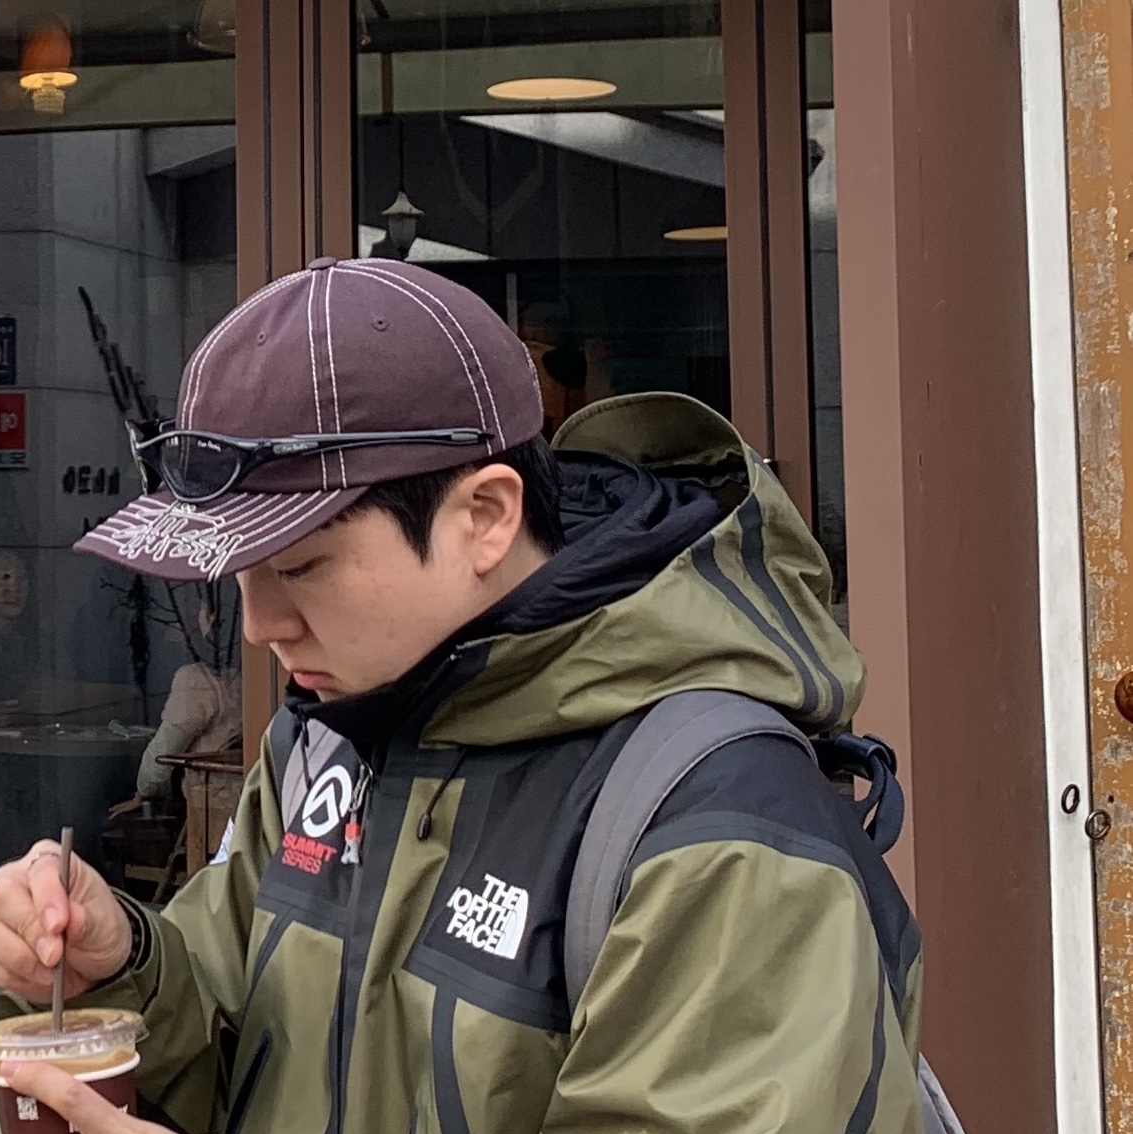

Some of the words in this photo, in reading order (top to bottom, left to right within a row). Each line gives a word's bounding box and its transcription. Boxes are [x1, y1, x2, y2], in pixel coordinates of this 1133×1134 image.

[281, 850, 322, 875] SERIES
[282, 832, 337, 863] SUMMIT
[482, 873, 522, 910] THE
[446, 911, 504, 954] FACE
